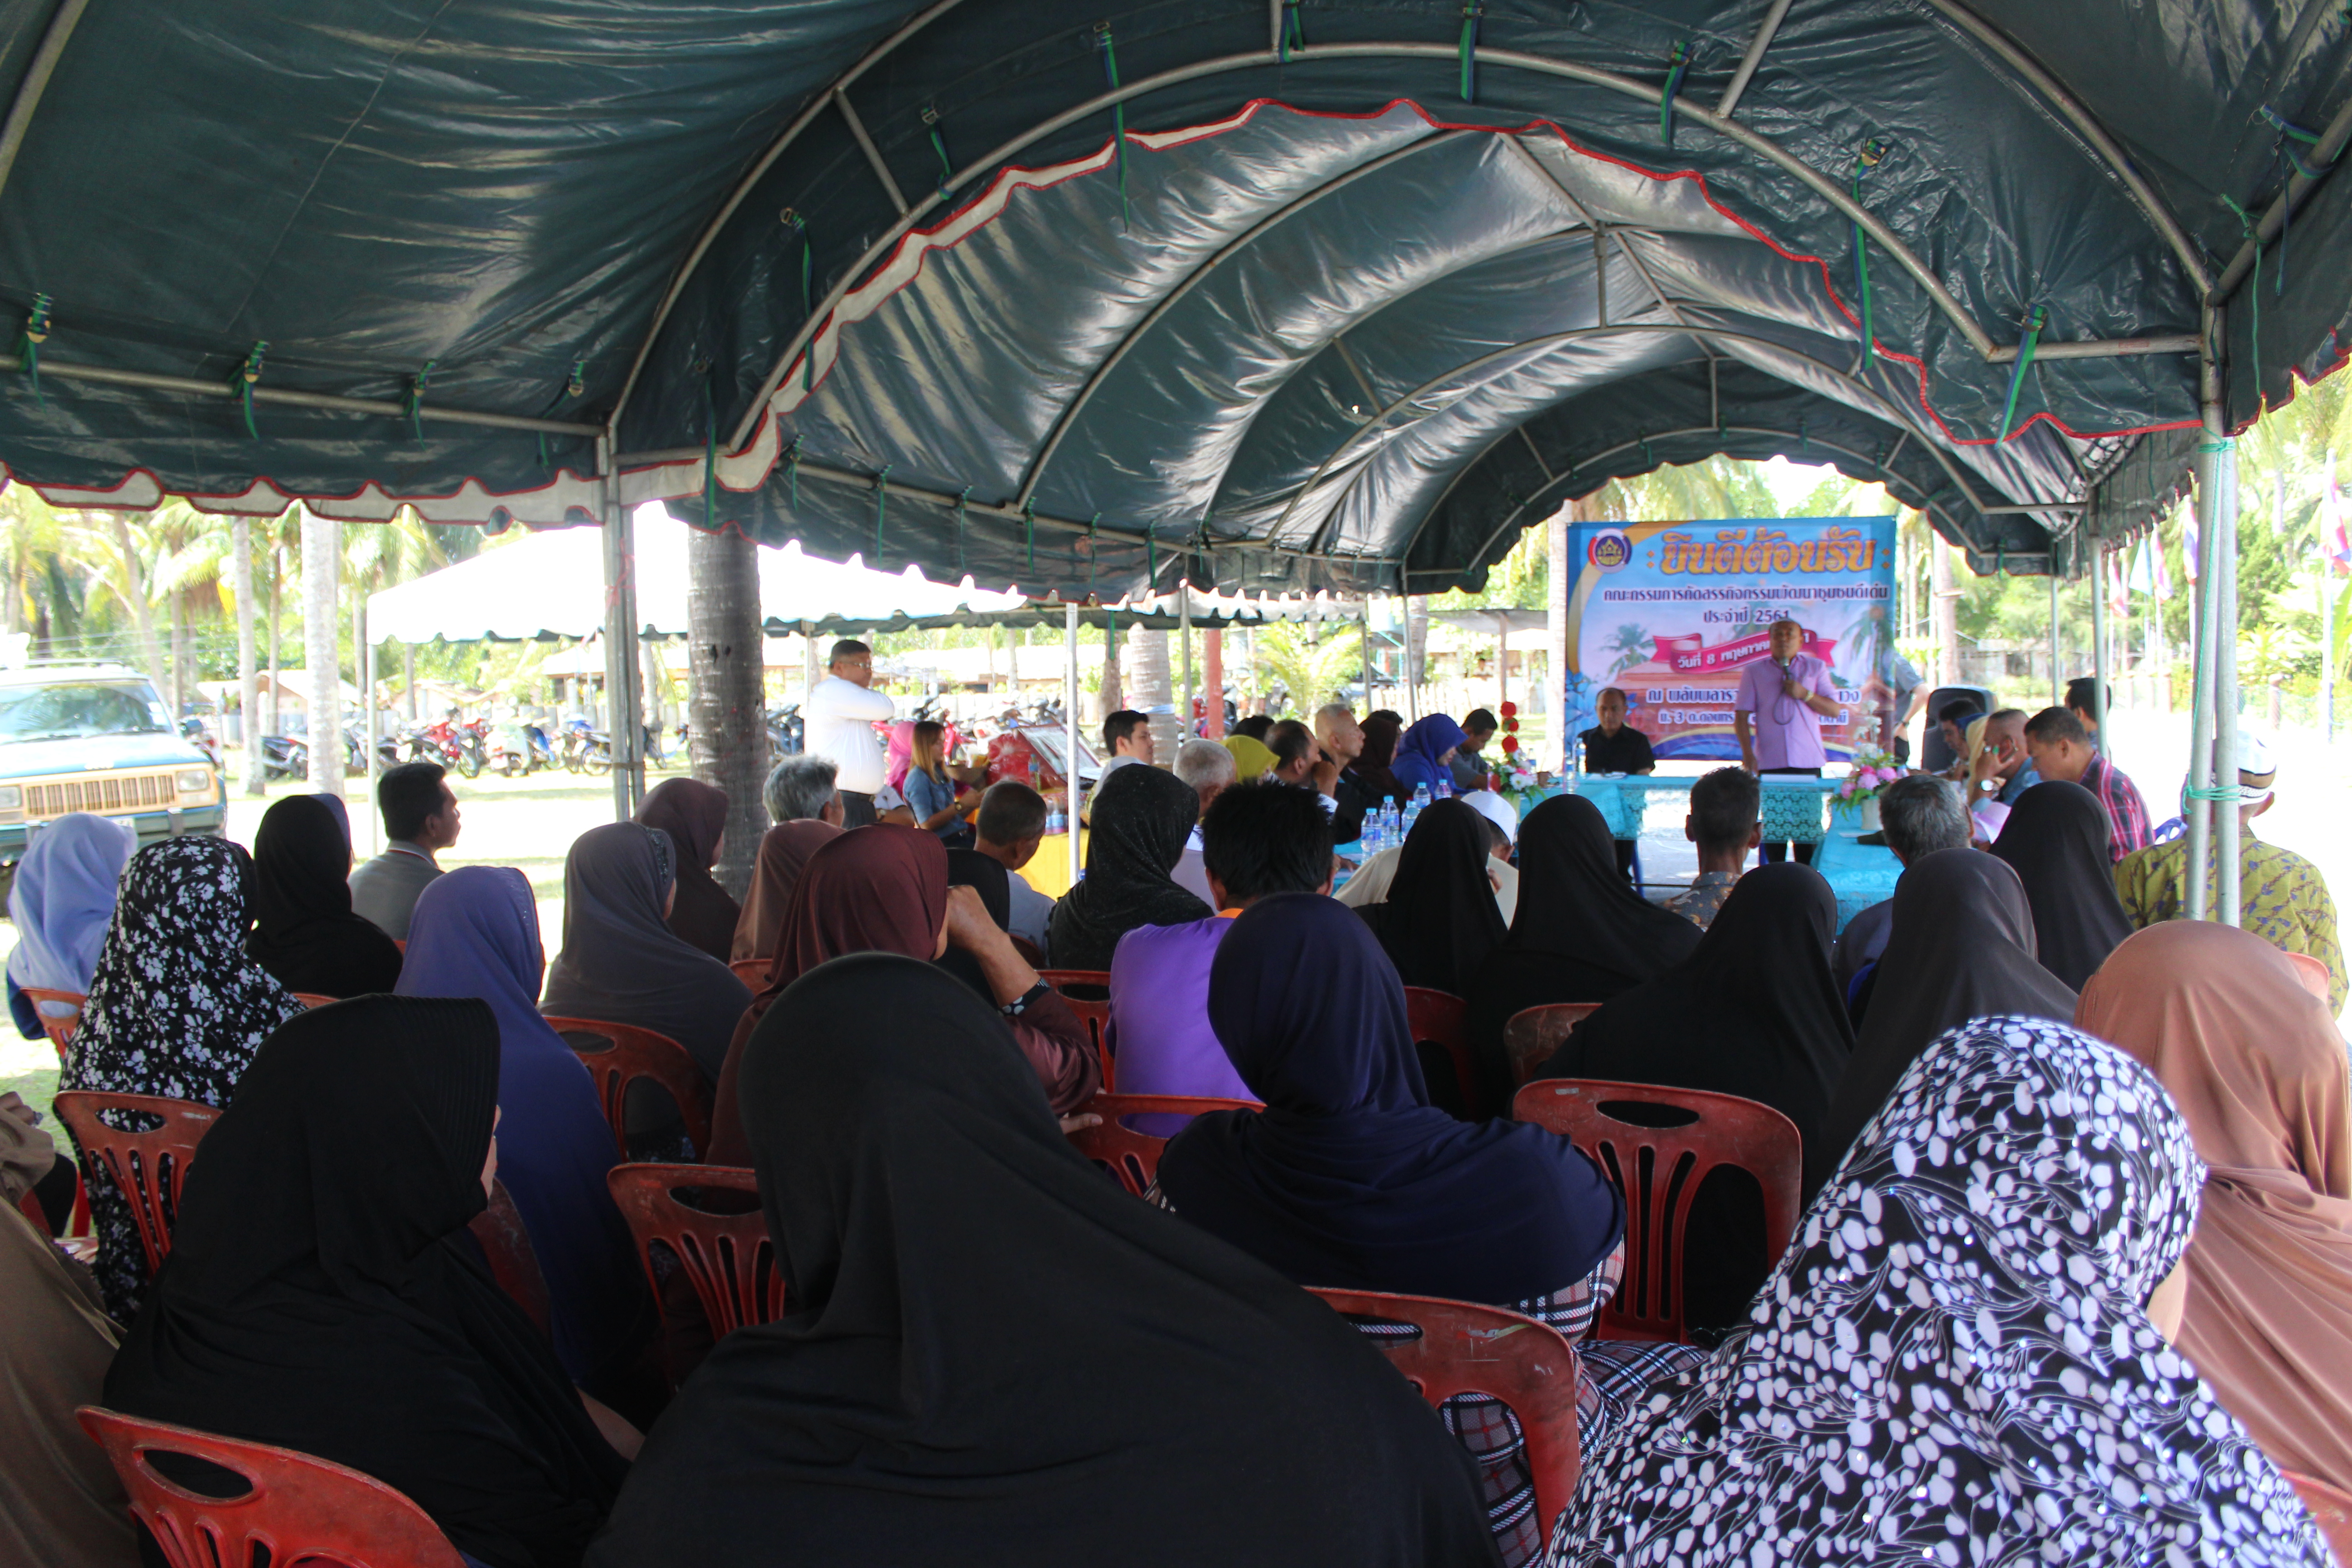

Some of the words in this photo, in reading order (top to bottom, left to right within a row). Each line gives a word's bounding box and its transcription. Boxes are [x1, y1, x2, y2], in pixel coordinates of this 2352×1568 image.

[1661, 525, 1877, 574] ยินดีต้อนรับ
[1604, 583, 1887, 602] คณะกรรมการคัดสรรกิจกรรมพัฒนาชุมชนดีเด่น
[1703, 607, 1748, 623] ประจำปี
[1755, 609, 1789, 623] 2561
[1677, 652, 1701, 669] วันที่
[1706, 654, 1715, 665] 8
[1676, 711, 1683, 722] 3
